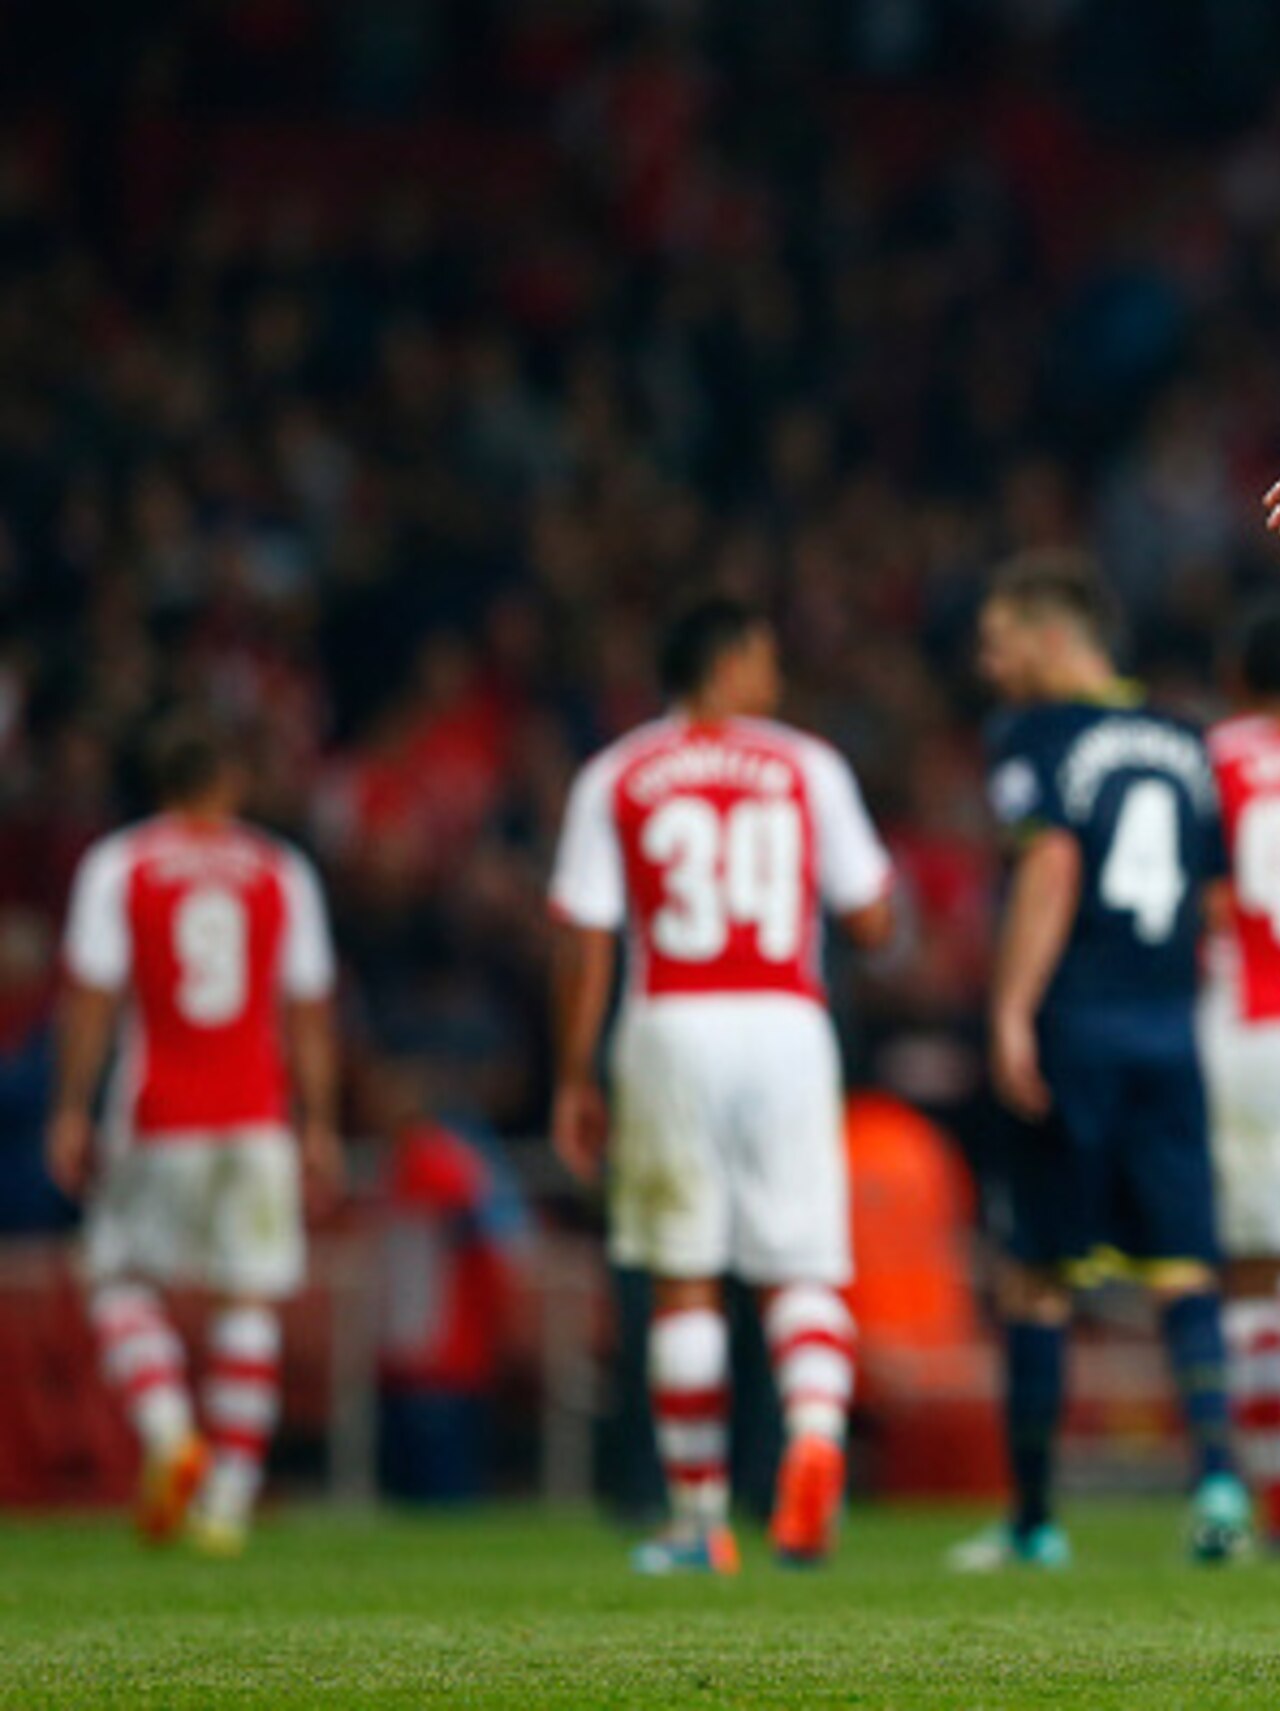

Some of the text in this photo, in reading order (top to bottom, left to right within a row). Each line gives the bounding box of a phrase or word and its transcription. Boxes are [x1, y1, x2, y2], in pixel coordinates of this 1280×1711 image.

[641, 796, 800, 962] 34
[1101, 777, 1185, 943] 4
[174, 888, 249, 1028] 9
